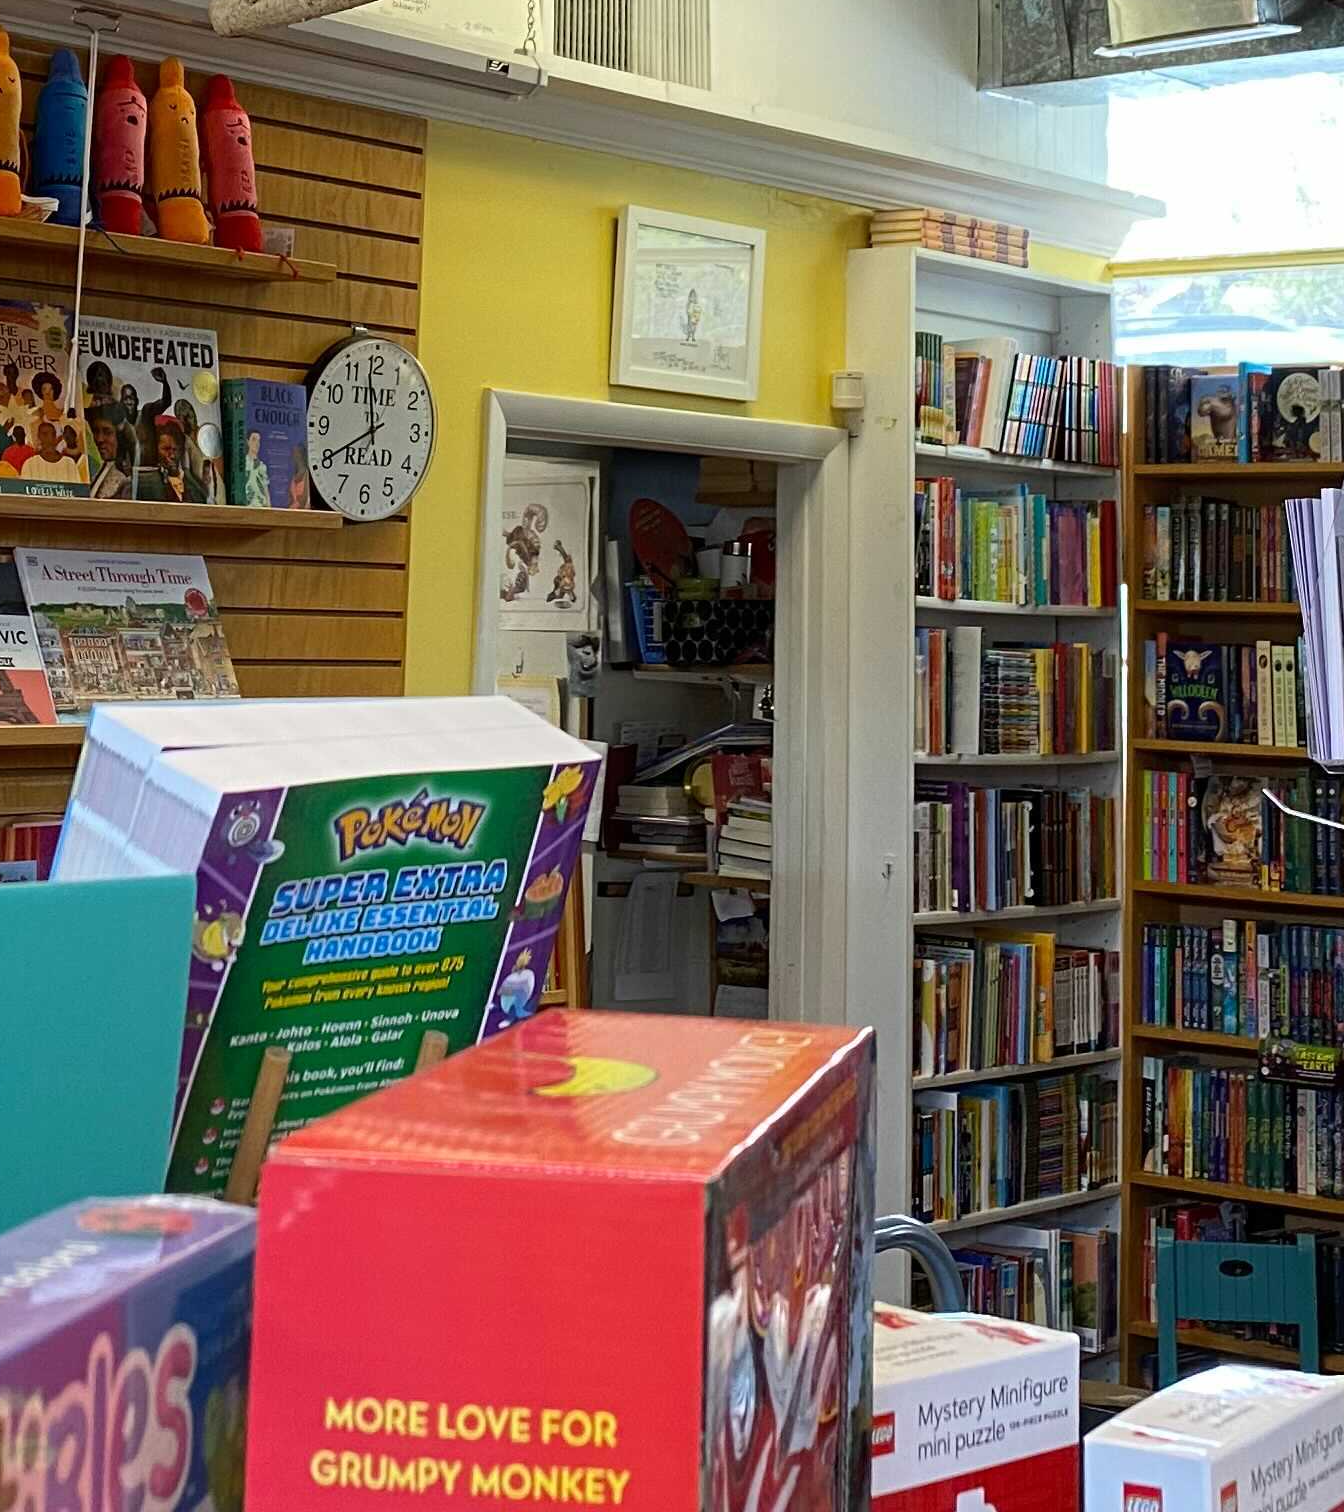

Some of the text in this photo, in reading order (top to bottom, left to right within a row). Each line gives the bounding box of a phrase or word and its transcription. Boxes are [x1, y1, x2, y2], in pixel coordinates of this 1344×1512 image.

[78, 328, 214, 369] THE UNDEFEATED
[344, 355, 401, 386] 11 12 1
[260, 388, 295, 404] BLACK
[325, 384, 419, 411] 10 TIME 2
[254, 409, 301, 427] ENOUGH
[318, 415, 330, 435] 9
[409, 423, 421, 443] 3
[321, 446, 412, 474] 8 READ 4
[337, 474, 394, 505] 7 6 5
[0, 628, 29, 646] VIC
[269, 858, 509, 918] SUPER EXTRA
[259, 895, 500, 947] DELUXE ESSENTIAL
[302, 927, 445, 966] HANDBOOK
[229, 1006, 460, 1048] Kanto Johto Hoenn Sinnoh Unova
[286, 1028, 406, 1053] Kalos Alola Galar
[324, 1396, 619, 1448] MORE LOVE FOR
[917, 1374, 1070, 1435] Mystery Minifigure
[917, 1421, 1006, 1462] mini puzzle
[309, 1449, 632, 1506] GRUMPY MONKEY
